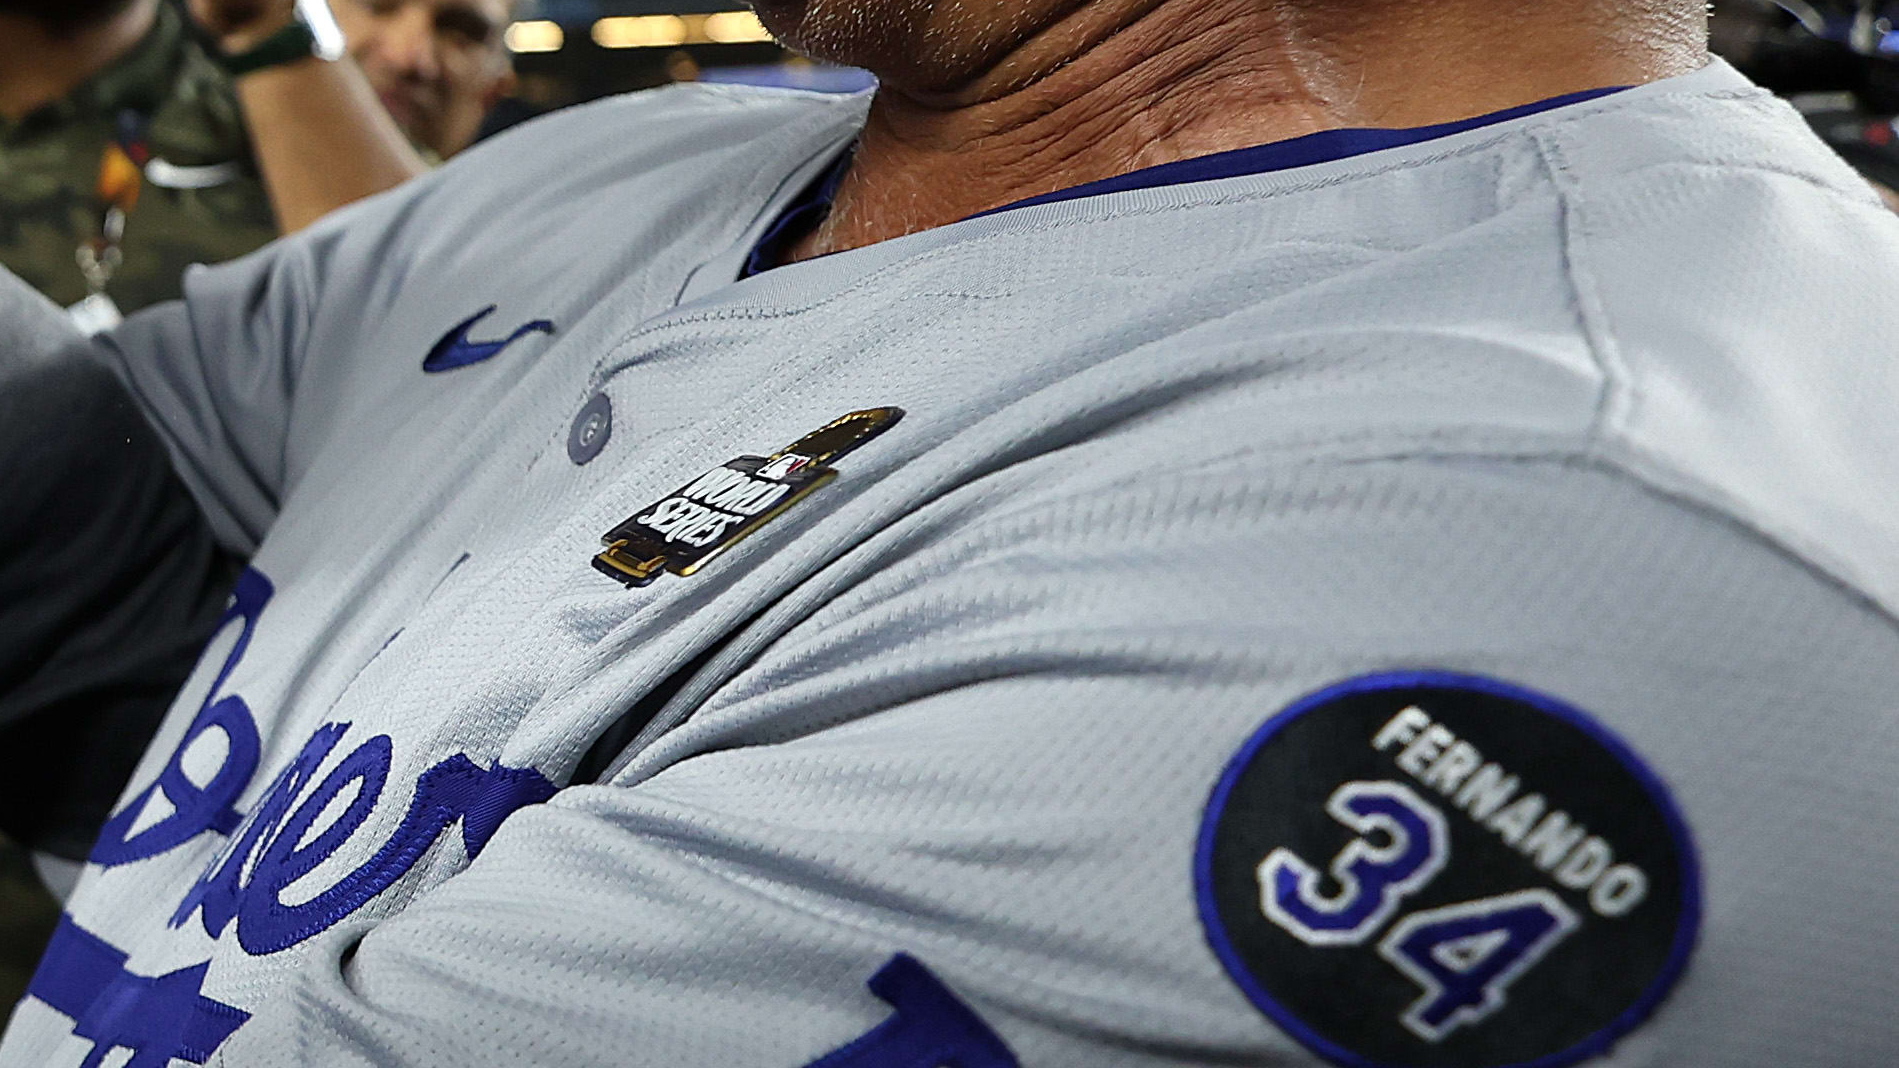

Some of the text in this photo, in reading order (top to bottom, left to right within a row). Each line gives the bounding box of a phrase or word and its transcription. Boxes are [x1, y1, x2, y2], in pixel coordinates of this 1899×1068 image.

[637, 496, 746, 548] SERIES
[682, 466, 791, 516] WORLD
[1371, 704, 1649, 918] FERNANDO
[1256, 778, 1583, 1043] 34
